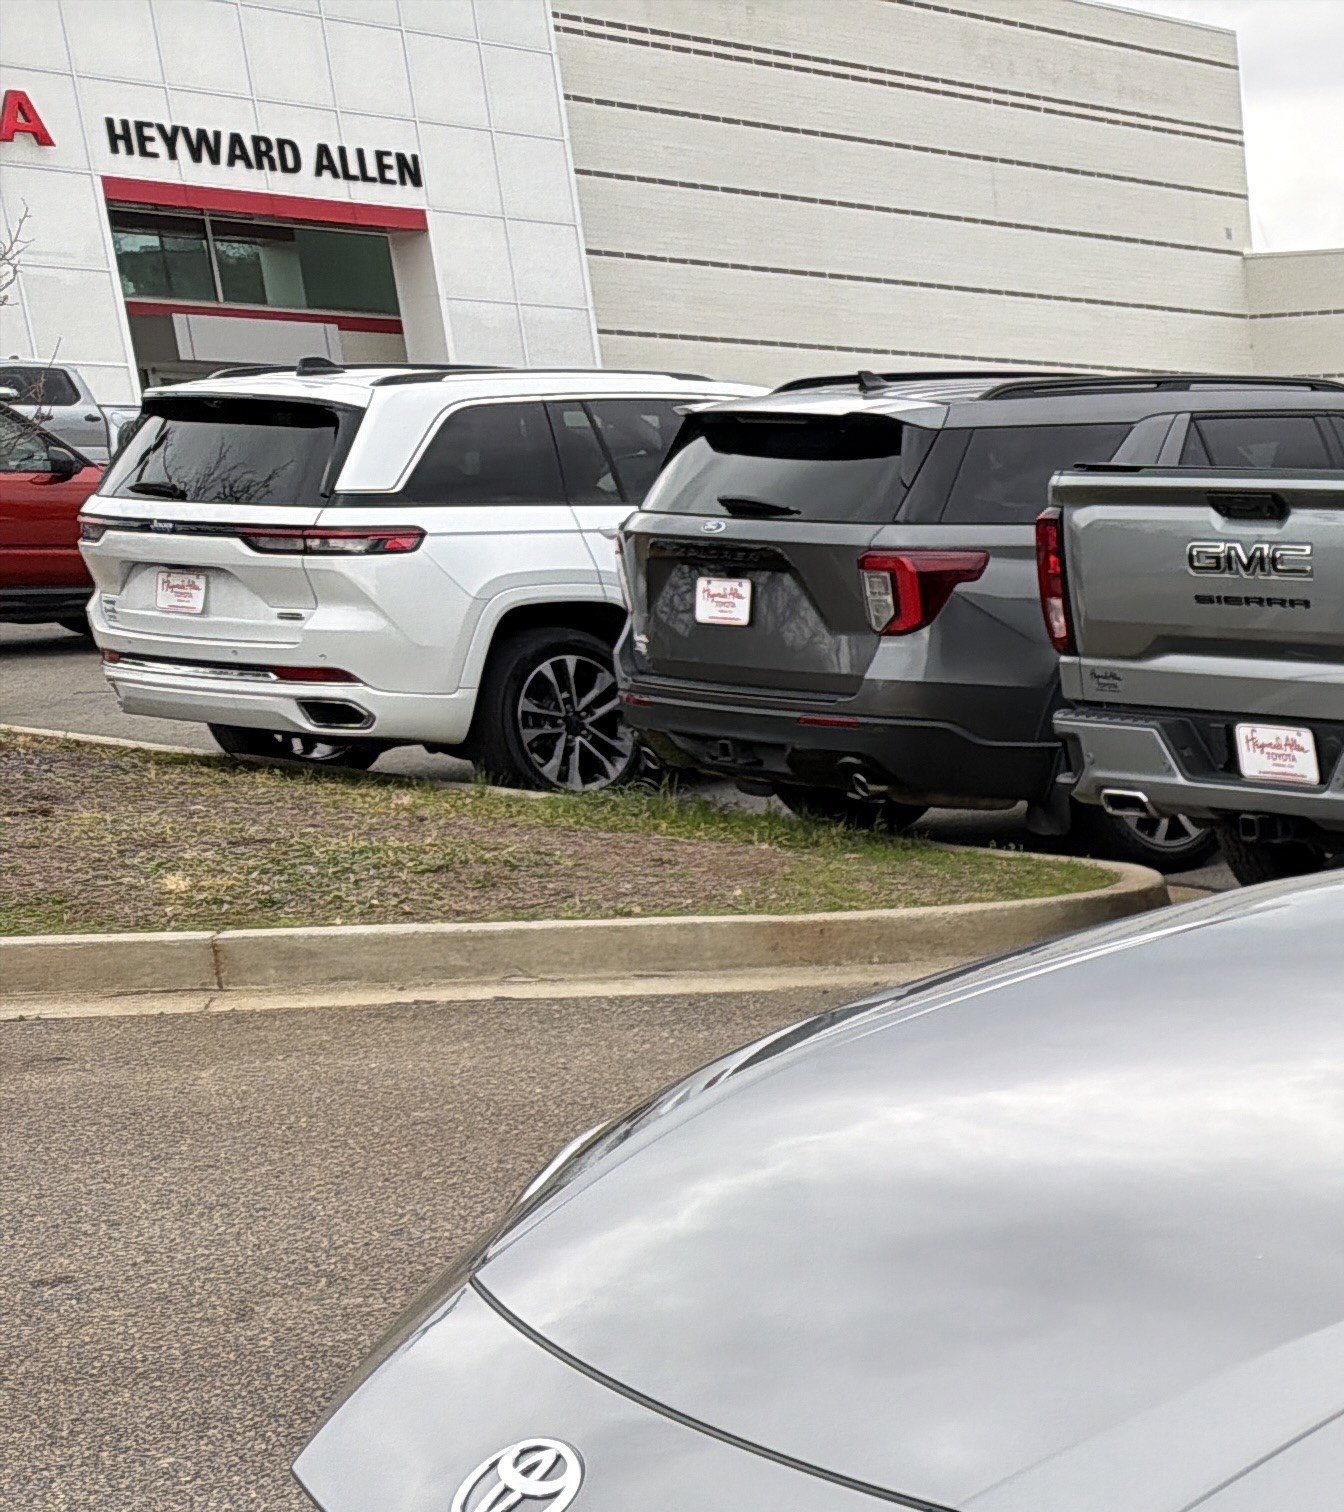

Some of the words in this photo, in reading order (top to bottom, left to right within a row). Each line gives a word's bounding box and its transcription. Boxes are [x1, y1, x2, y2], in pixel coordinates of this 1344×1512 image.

[104, 116, 301, 174] HEYWARD
[315, 142, 424, 188] ALLEN
[1186, 541, 1314, 582] GMC
[1193, 593, 1312, 610] SIERRA
